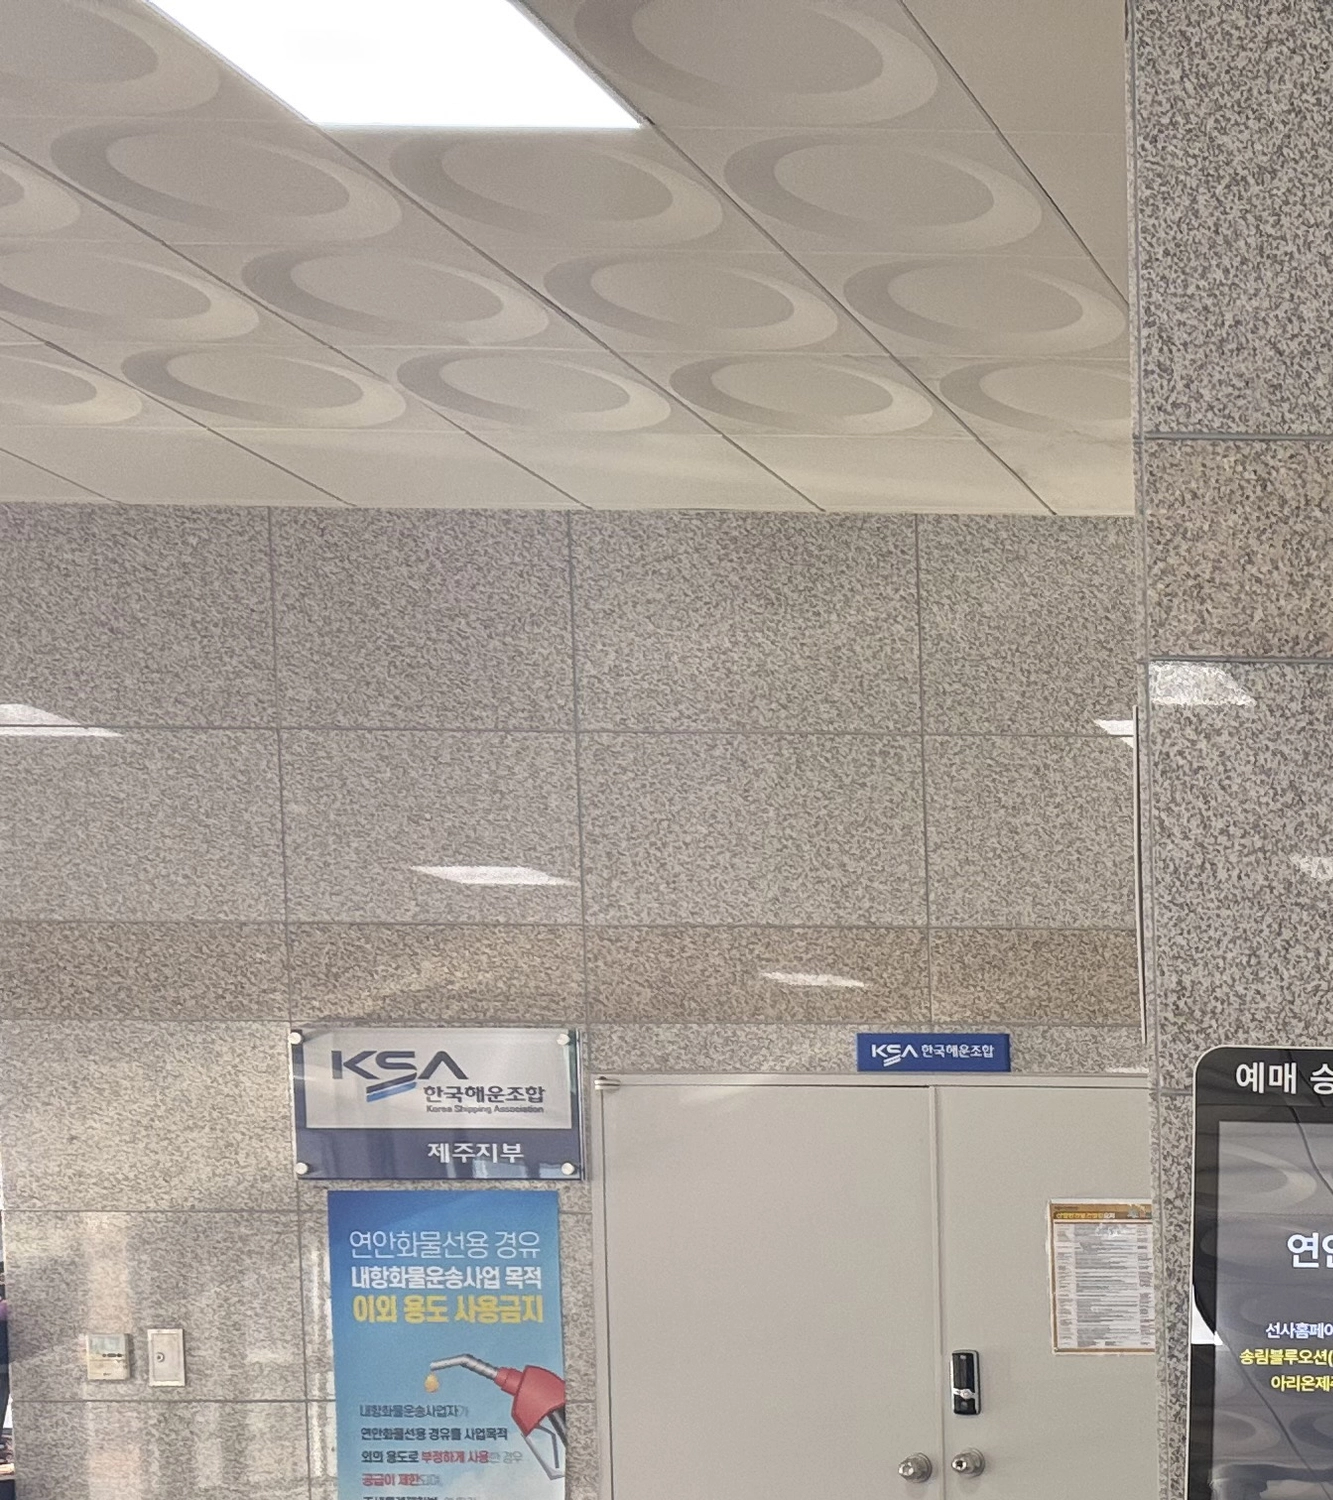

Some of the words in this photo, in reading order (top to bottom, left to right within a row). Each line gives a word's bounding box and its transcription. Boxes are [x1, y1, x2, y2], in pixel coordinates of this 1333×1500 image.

[871, 1043, 918, 1067] KSA
[922, 1044, 995, 1058] 한국해운조합
[331, 1050, 469, 1103] KSA
[1236, 1062, 1297, 1095] 예매
[423, 1086, 545, 1103] 한국해운조합
[428, 1143, 524, 1163] 제주지부
[350, 1231, 488, 1259] 연안화물선용
[495, 1231, 541, 1259] 경유
[351, 1266, 500, 1289] 내항화물운송사업
[505, 1266, 542, 1289] 목적
[353, 1294, 398, 1323] 이외
[403, 1294, 449, 1323] 용도
[455, 1294, 544, 1323] 사용금지
[361, 1451, 383, 1463] 외의
[386, 1451, 419, 1463] 용도로
